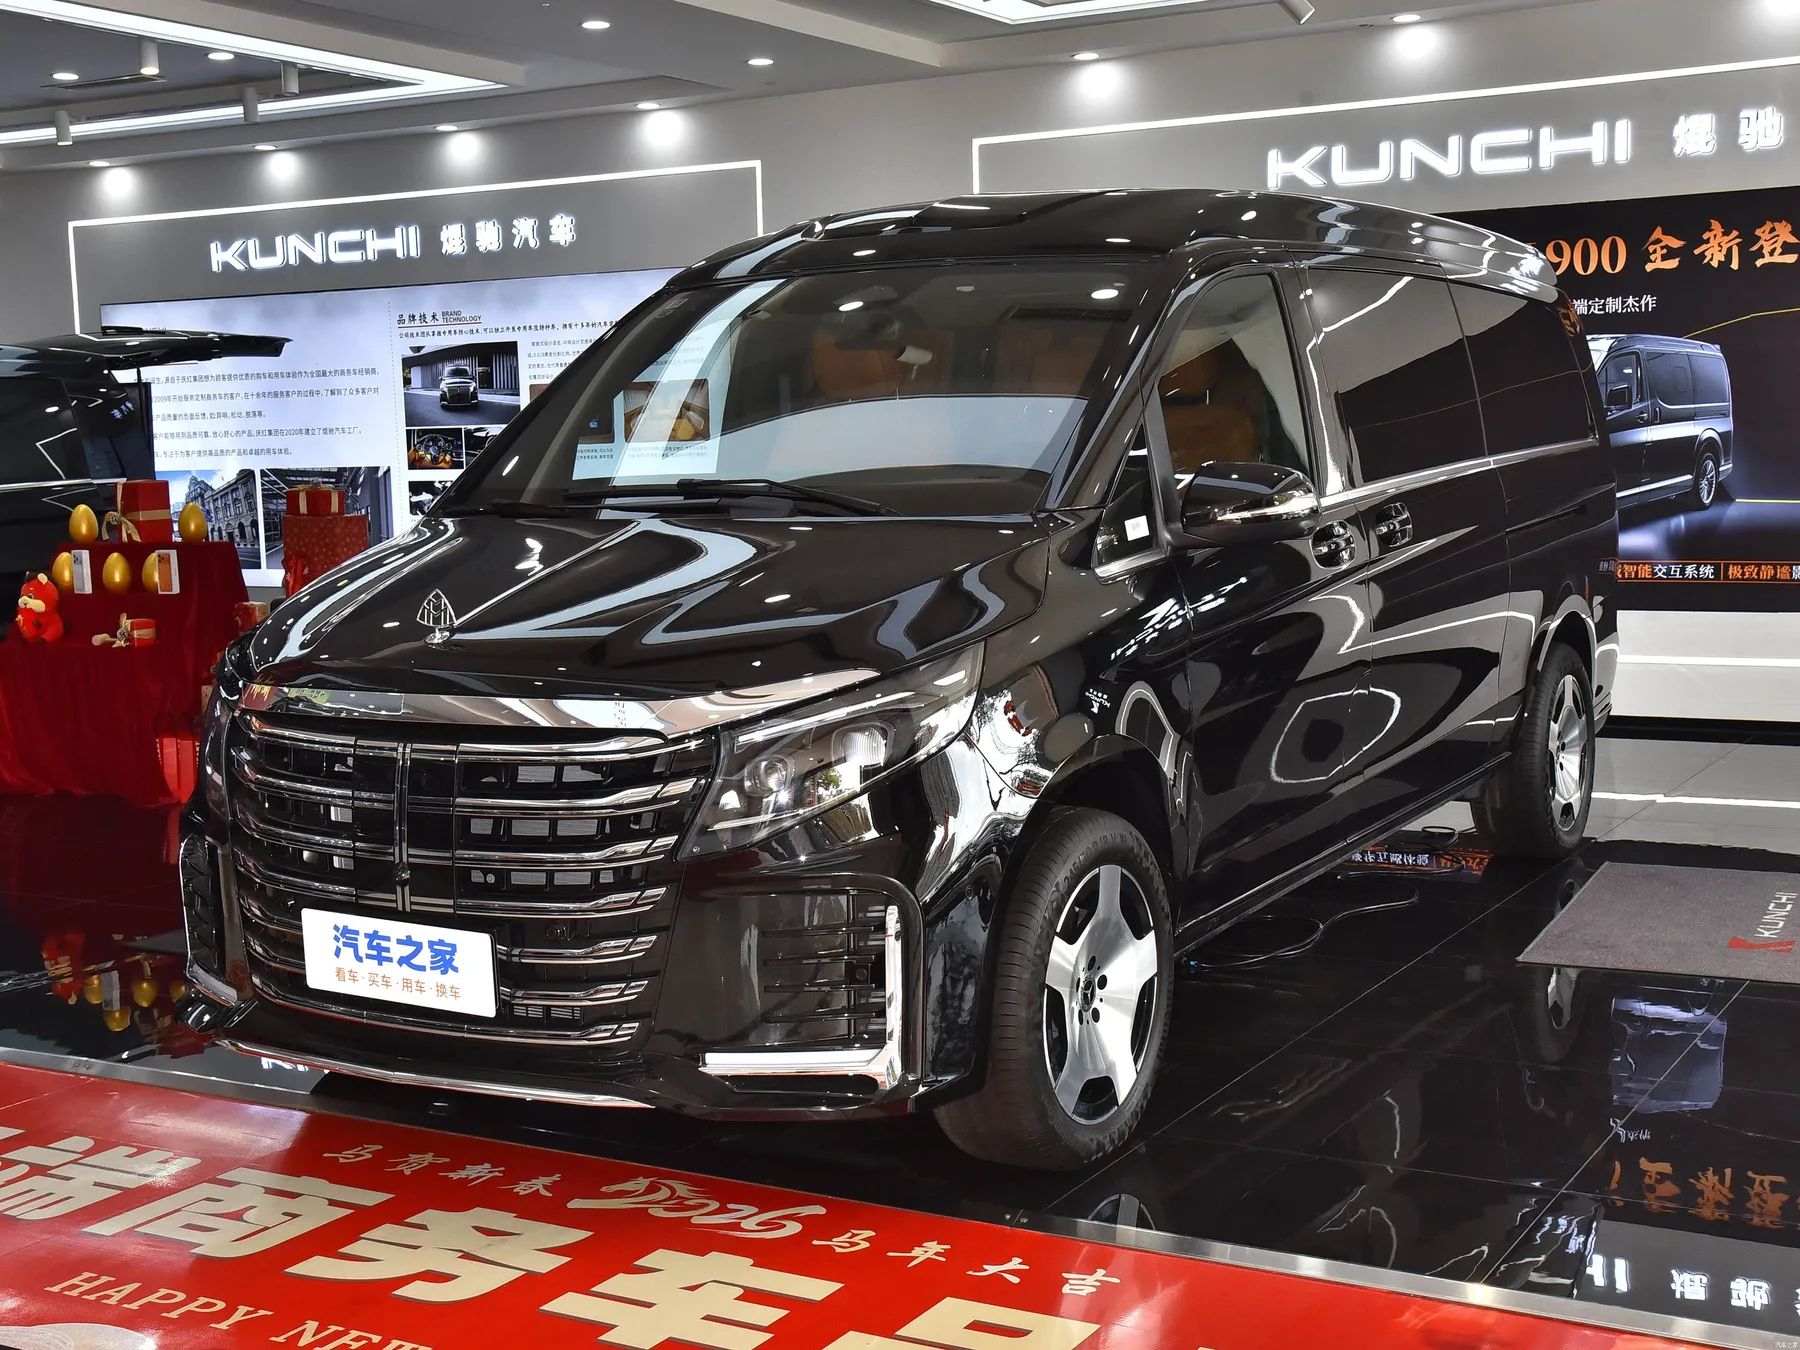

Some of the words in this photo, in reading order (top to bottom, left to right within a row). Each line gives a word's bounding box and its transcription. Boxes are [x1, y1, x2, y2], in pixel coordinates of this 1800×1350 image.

[1267, 119, 1631, 190] KUNCHI
[209, 225, 421, 273] KUNCHI
[1526, 235, 1627, 276] 900
[1641, 219, 1800, 272] 全新登
[397, 312, 439, 325] 品牌技术
[442, 315, 482, 323] TECHNOLOGY
[1753, 891, 1798, 938] KUNCHI
[333, 924, 459, 976] 汽车之家
[0, 1127, 1101, 1350] 端商务车
[812, 1229, 1121, 1297] 马年大吉
[44, 1272, 274, 1331] HAPPY
